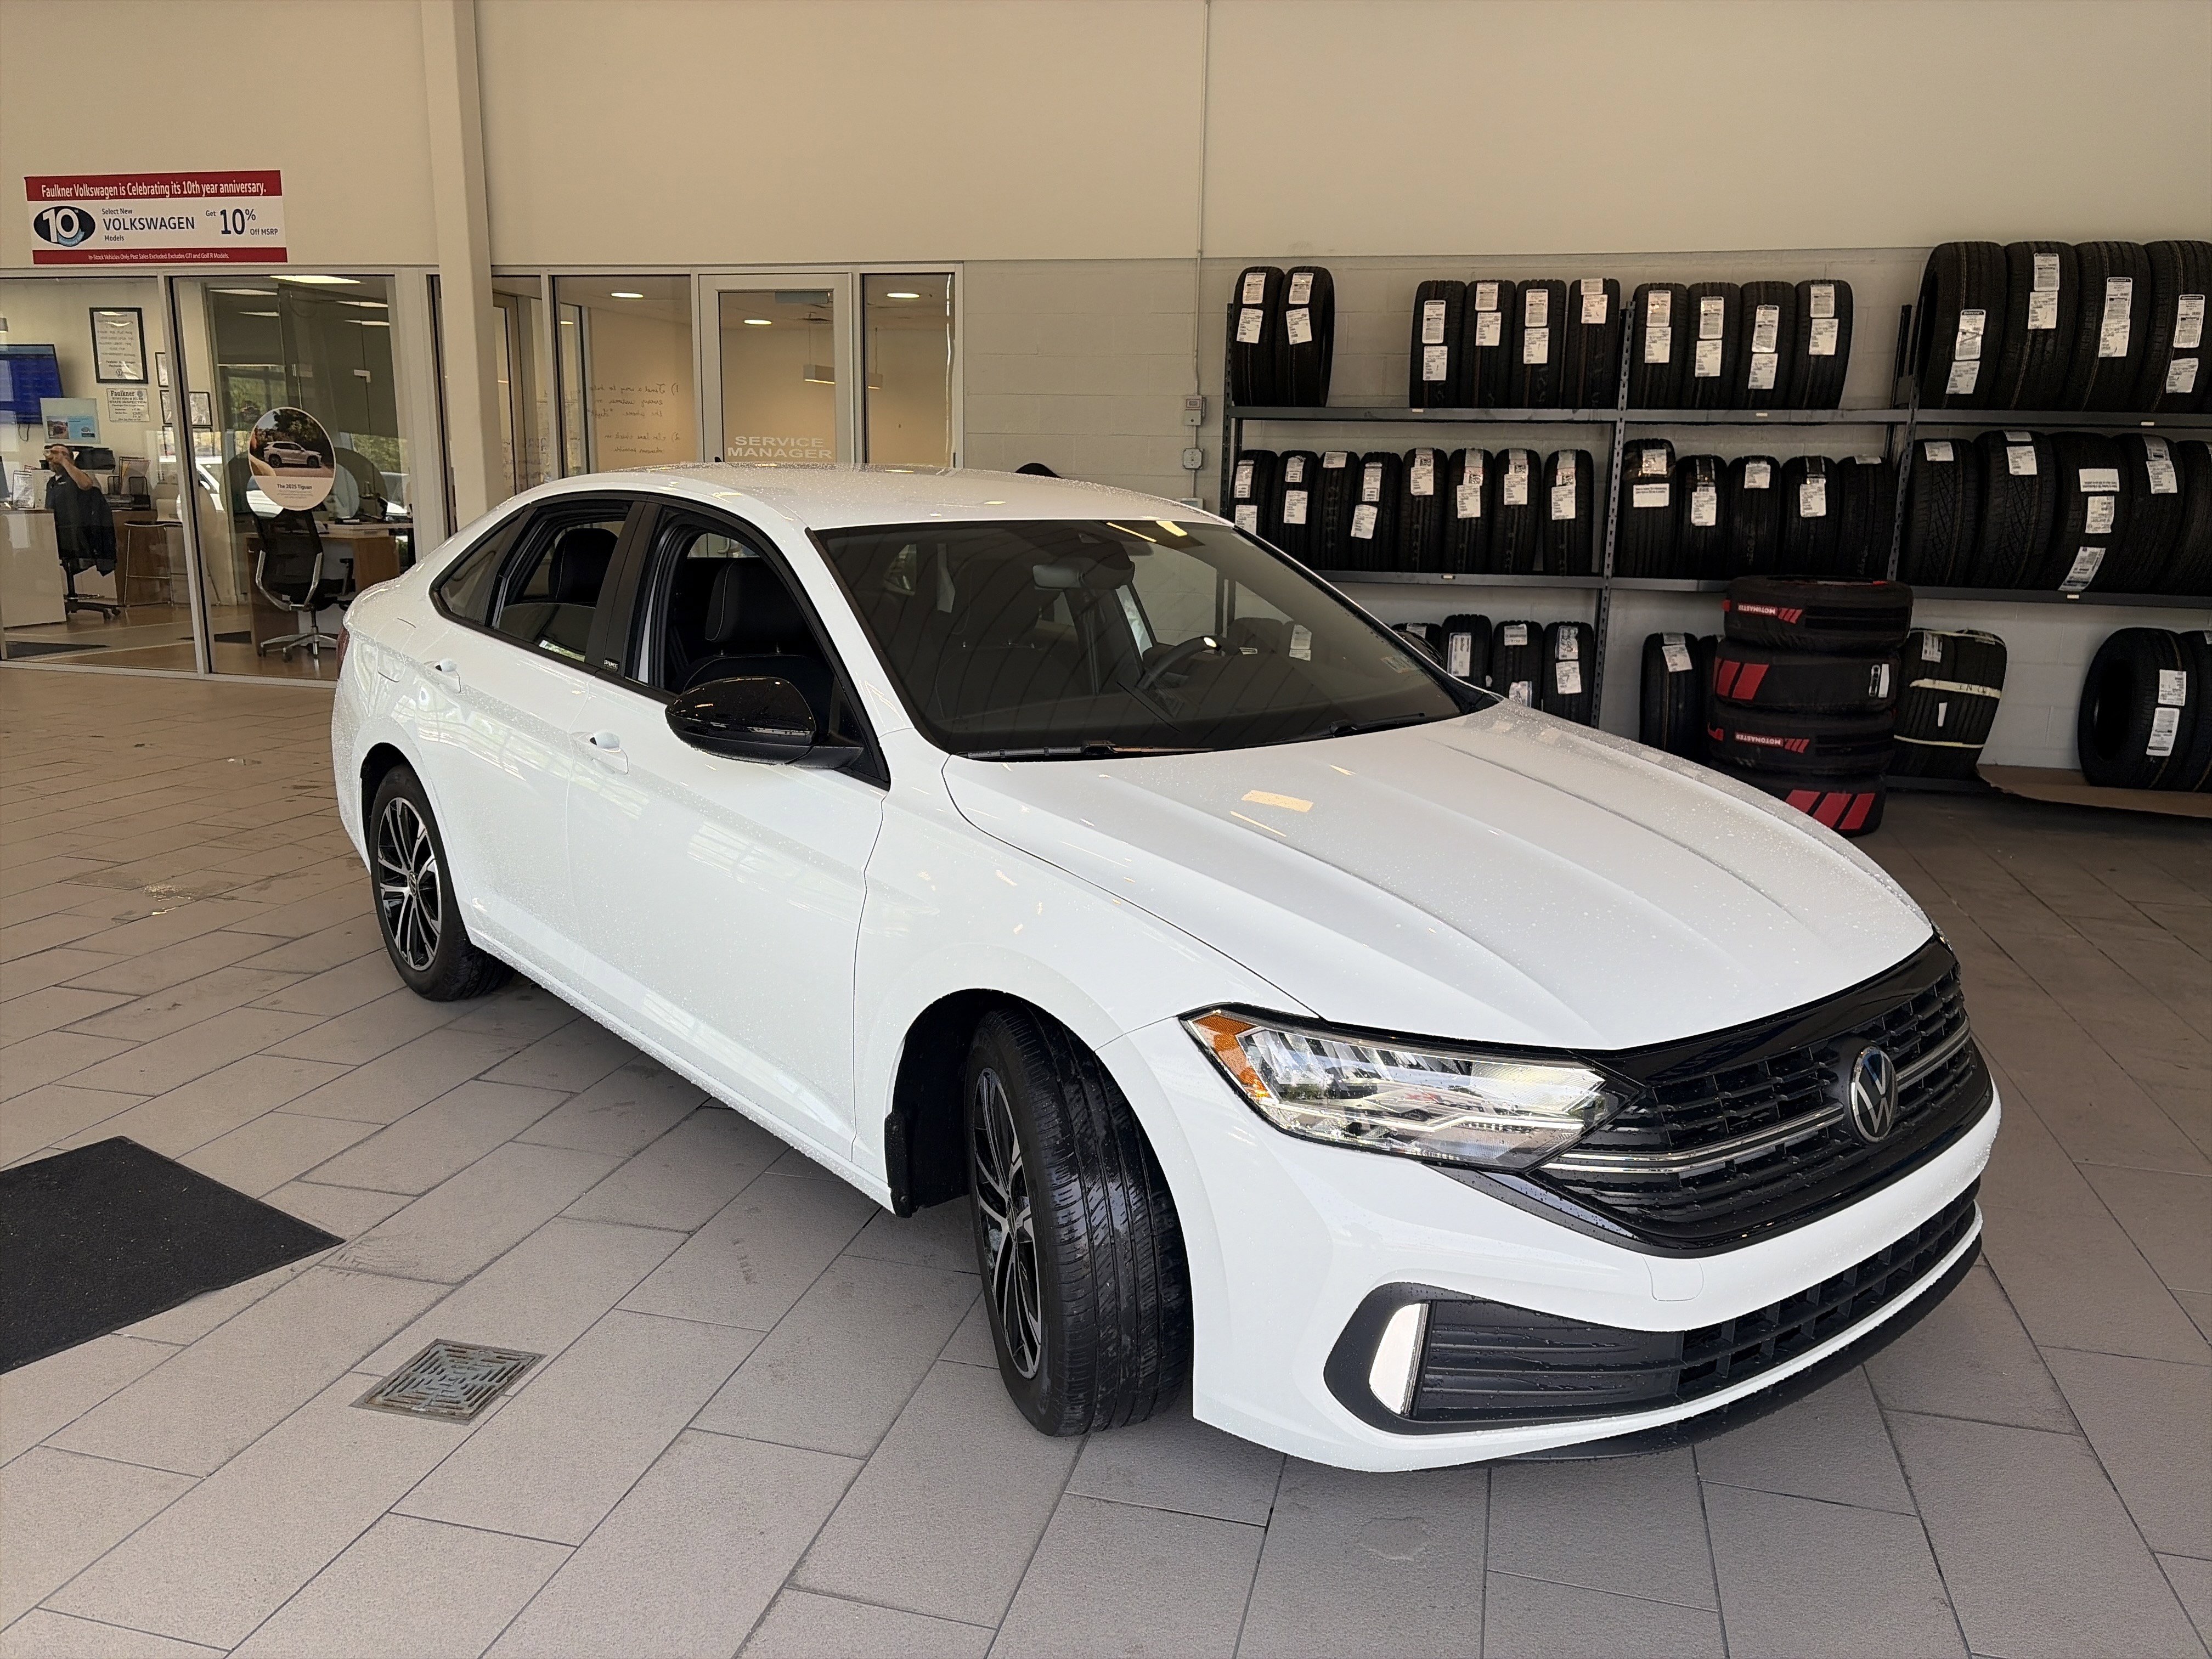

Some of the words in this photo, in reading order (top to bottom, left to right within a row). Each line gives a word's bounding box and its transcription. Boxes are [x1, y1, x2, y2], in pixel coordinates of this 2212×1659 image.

[42, 184, 73, 198] Faulkner
[74, 183, 118, 200] Volkswagen
[119, 183, 126, 196] is
[127, 181, 170, 198] Celebrating
[182, 180, 200, 194] 10th
[201, 183, 218, 197] year
[219, 179, 267, 196] anniversary.
[43, 208, 80, 242] 10
[103, 216, 195, 231] VOLKSWAGEN
[735, 436, 823, 447] SERVICE
[727, 447, 833, 459] MANAGER
[1736, 734, 1781, 745] MOTOMASTER
